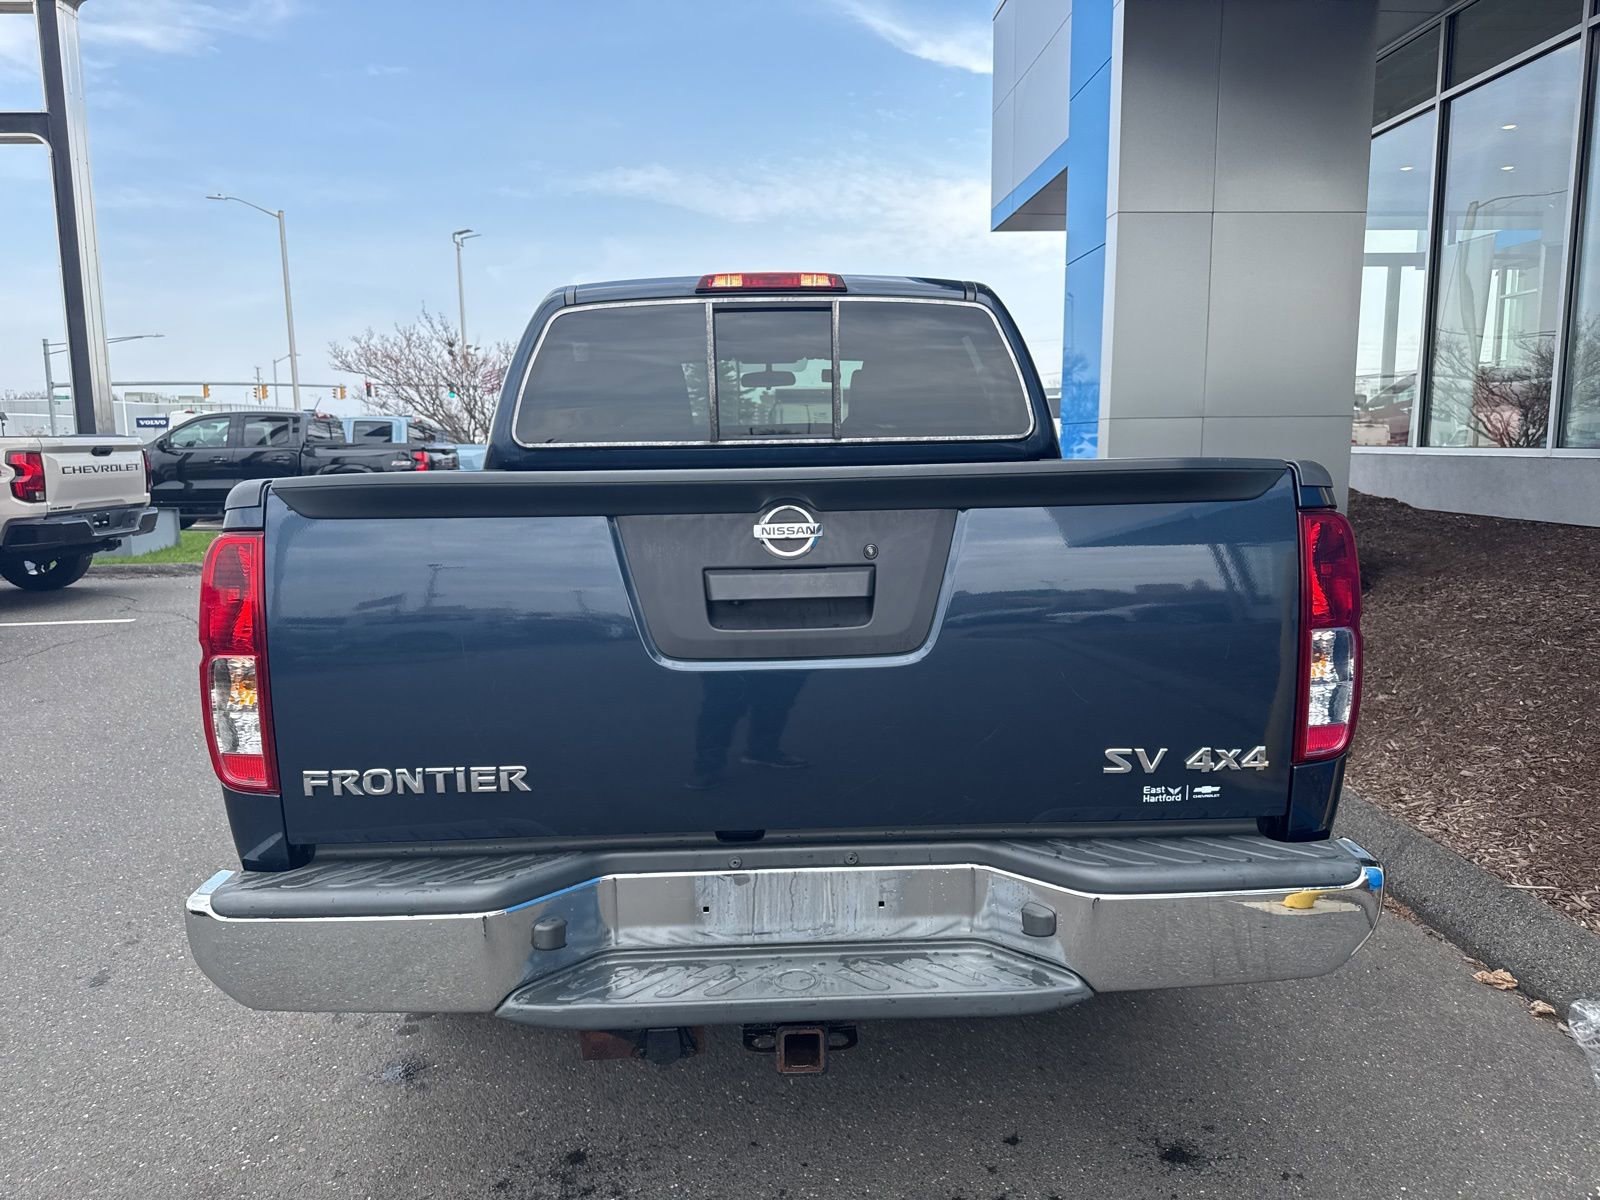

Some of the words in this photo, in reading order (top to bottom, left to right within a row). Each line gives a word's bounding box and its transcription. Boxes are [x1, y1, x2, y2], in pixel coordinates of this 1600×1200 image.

[61, 463, 140, 475] CHEVROLET
[761, 525, 816, 536] NISSAN
[1103, 748, 1168, 773] SV
[302, 765, 532, 797] FRONTIER
[1143, 785, 1166, 794] East
[1142, 793, 1182, 803] Hartford
